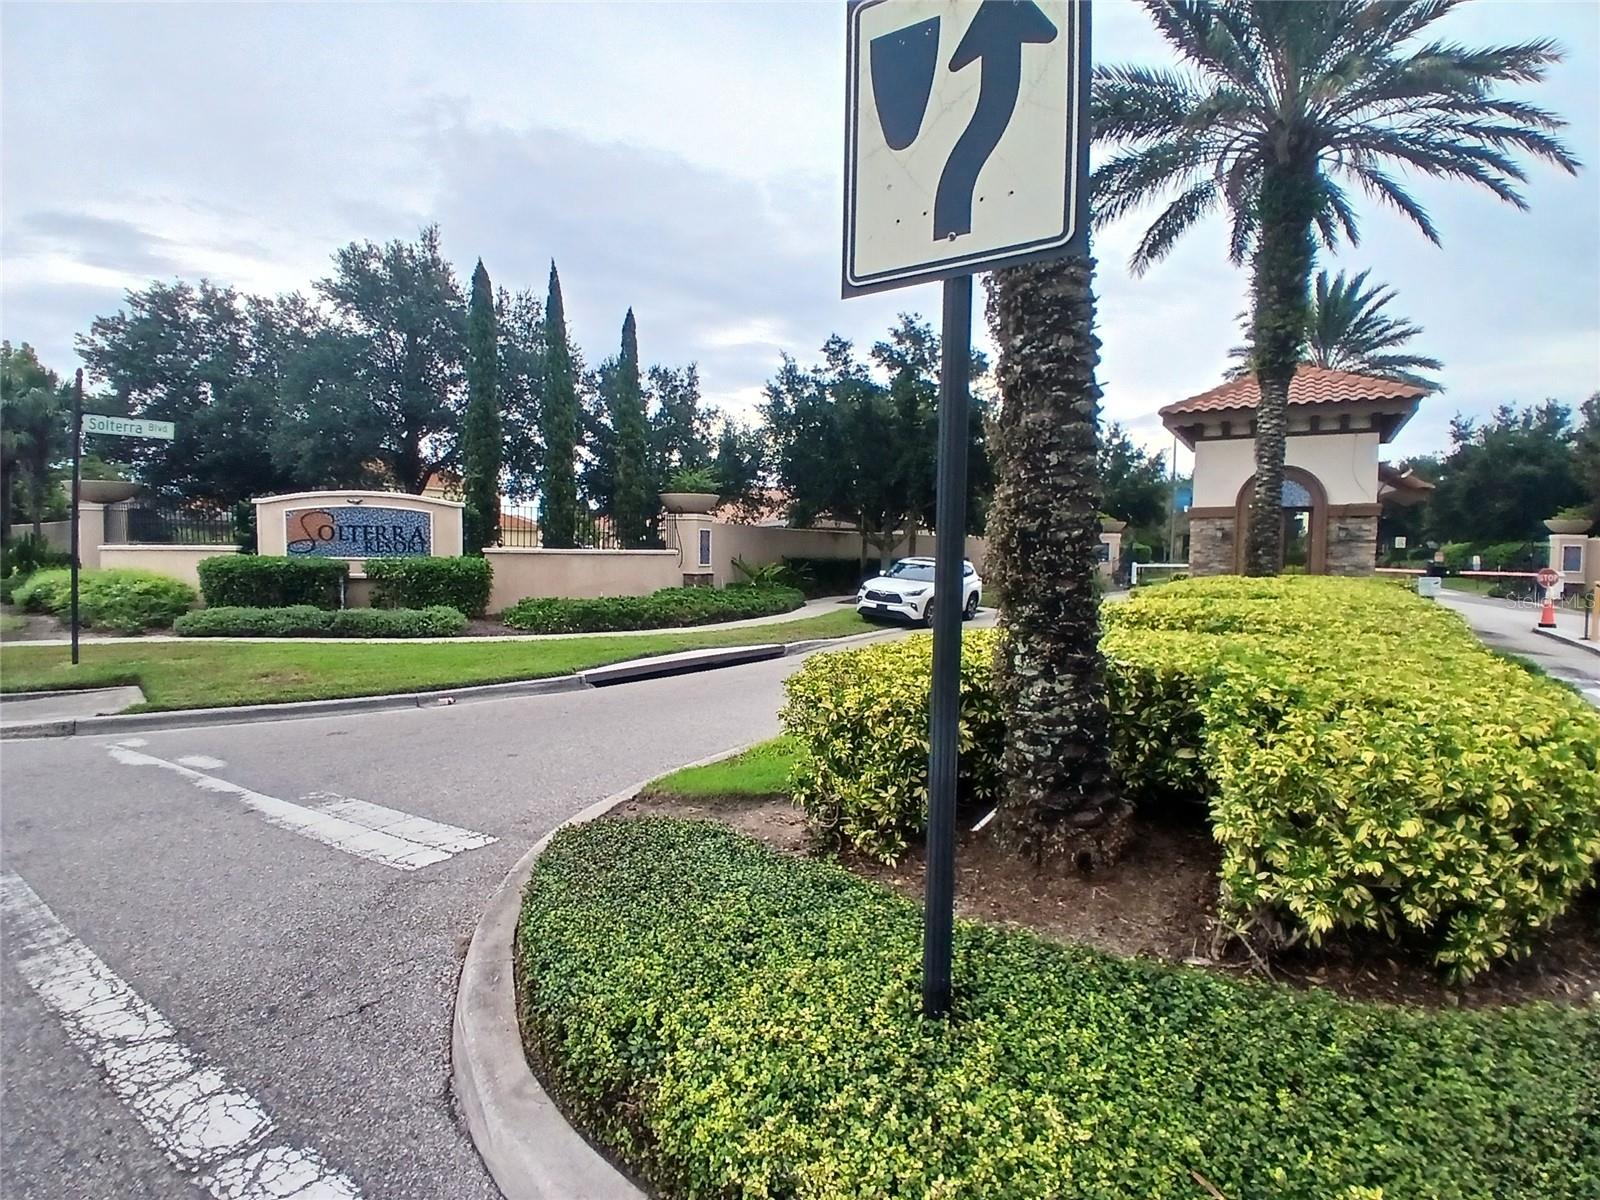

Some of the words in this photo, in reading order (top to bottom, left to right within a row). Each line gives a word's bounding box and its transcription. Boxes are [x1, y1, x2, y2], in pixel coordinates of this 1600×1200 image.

[88, 417, 143, 434] Solterra
[147, 422, 168, 433] Blvd
[287, 511, 426, 553] SOLTERRA
[365, 541, 425, 553] RESORT
[1540, 574, 1558, 582] STOP
